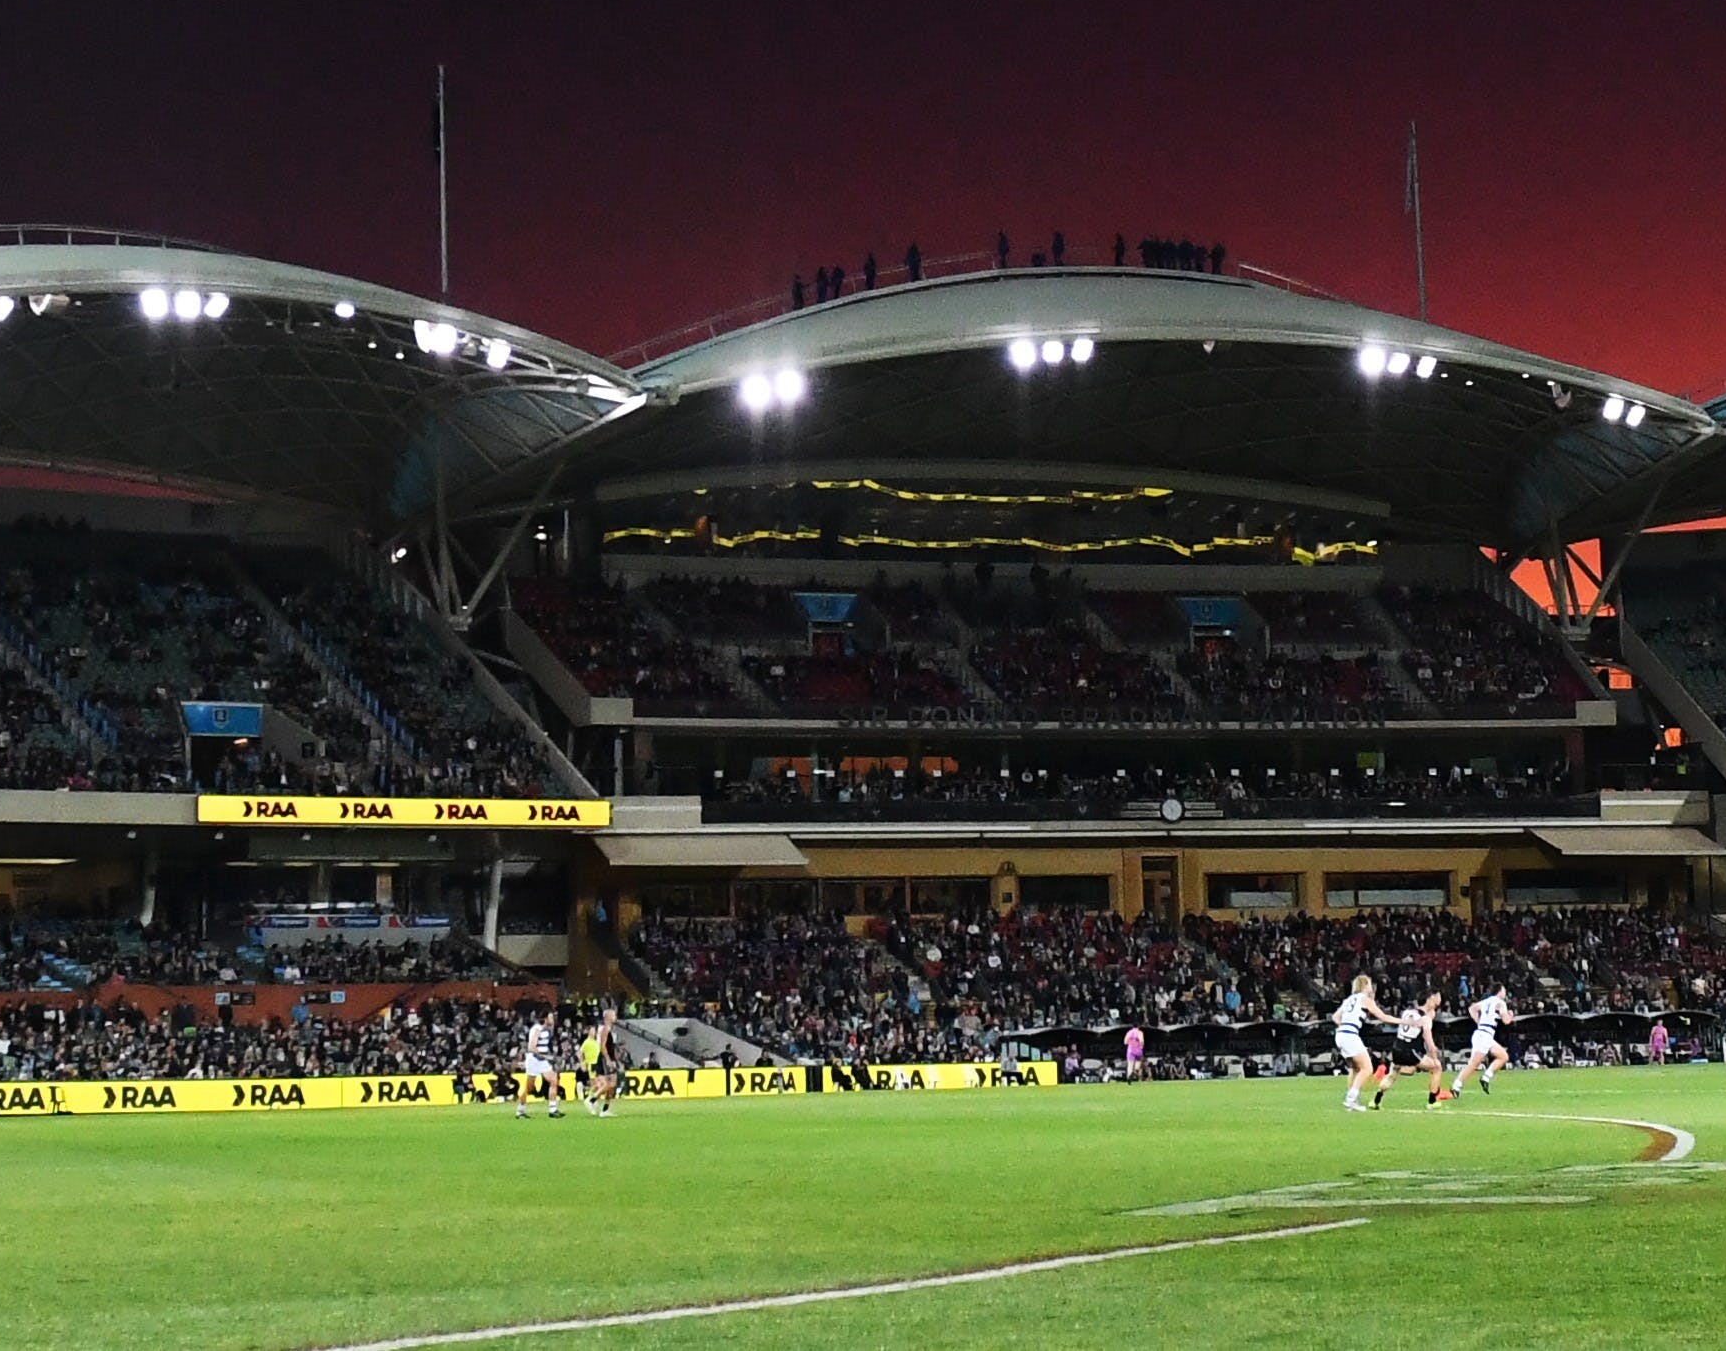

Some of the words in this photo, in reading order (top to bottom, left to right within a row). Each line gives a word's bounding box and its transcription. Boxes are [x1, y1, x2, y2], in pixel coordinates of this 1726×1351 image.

[256, 802, 299, 818] RAA
[353, 803, 394, 819] RAA
[447, 804, 489, 820] RAA
[541, 805, 581, 821] RAA
[250, 1084, 306, 1107] RAA
[378, 1080, 431, 1103] RAA
[626, 1075, 676, 1097] RAA
[121, 1086, 177, 1109] RAA
